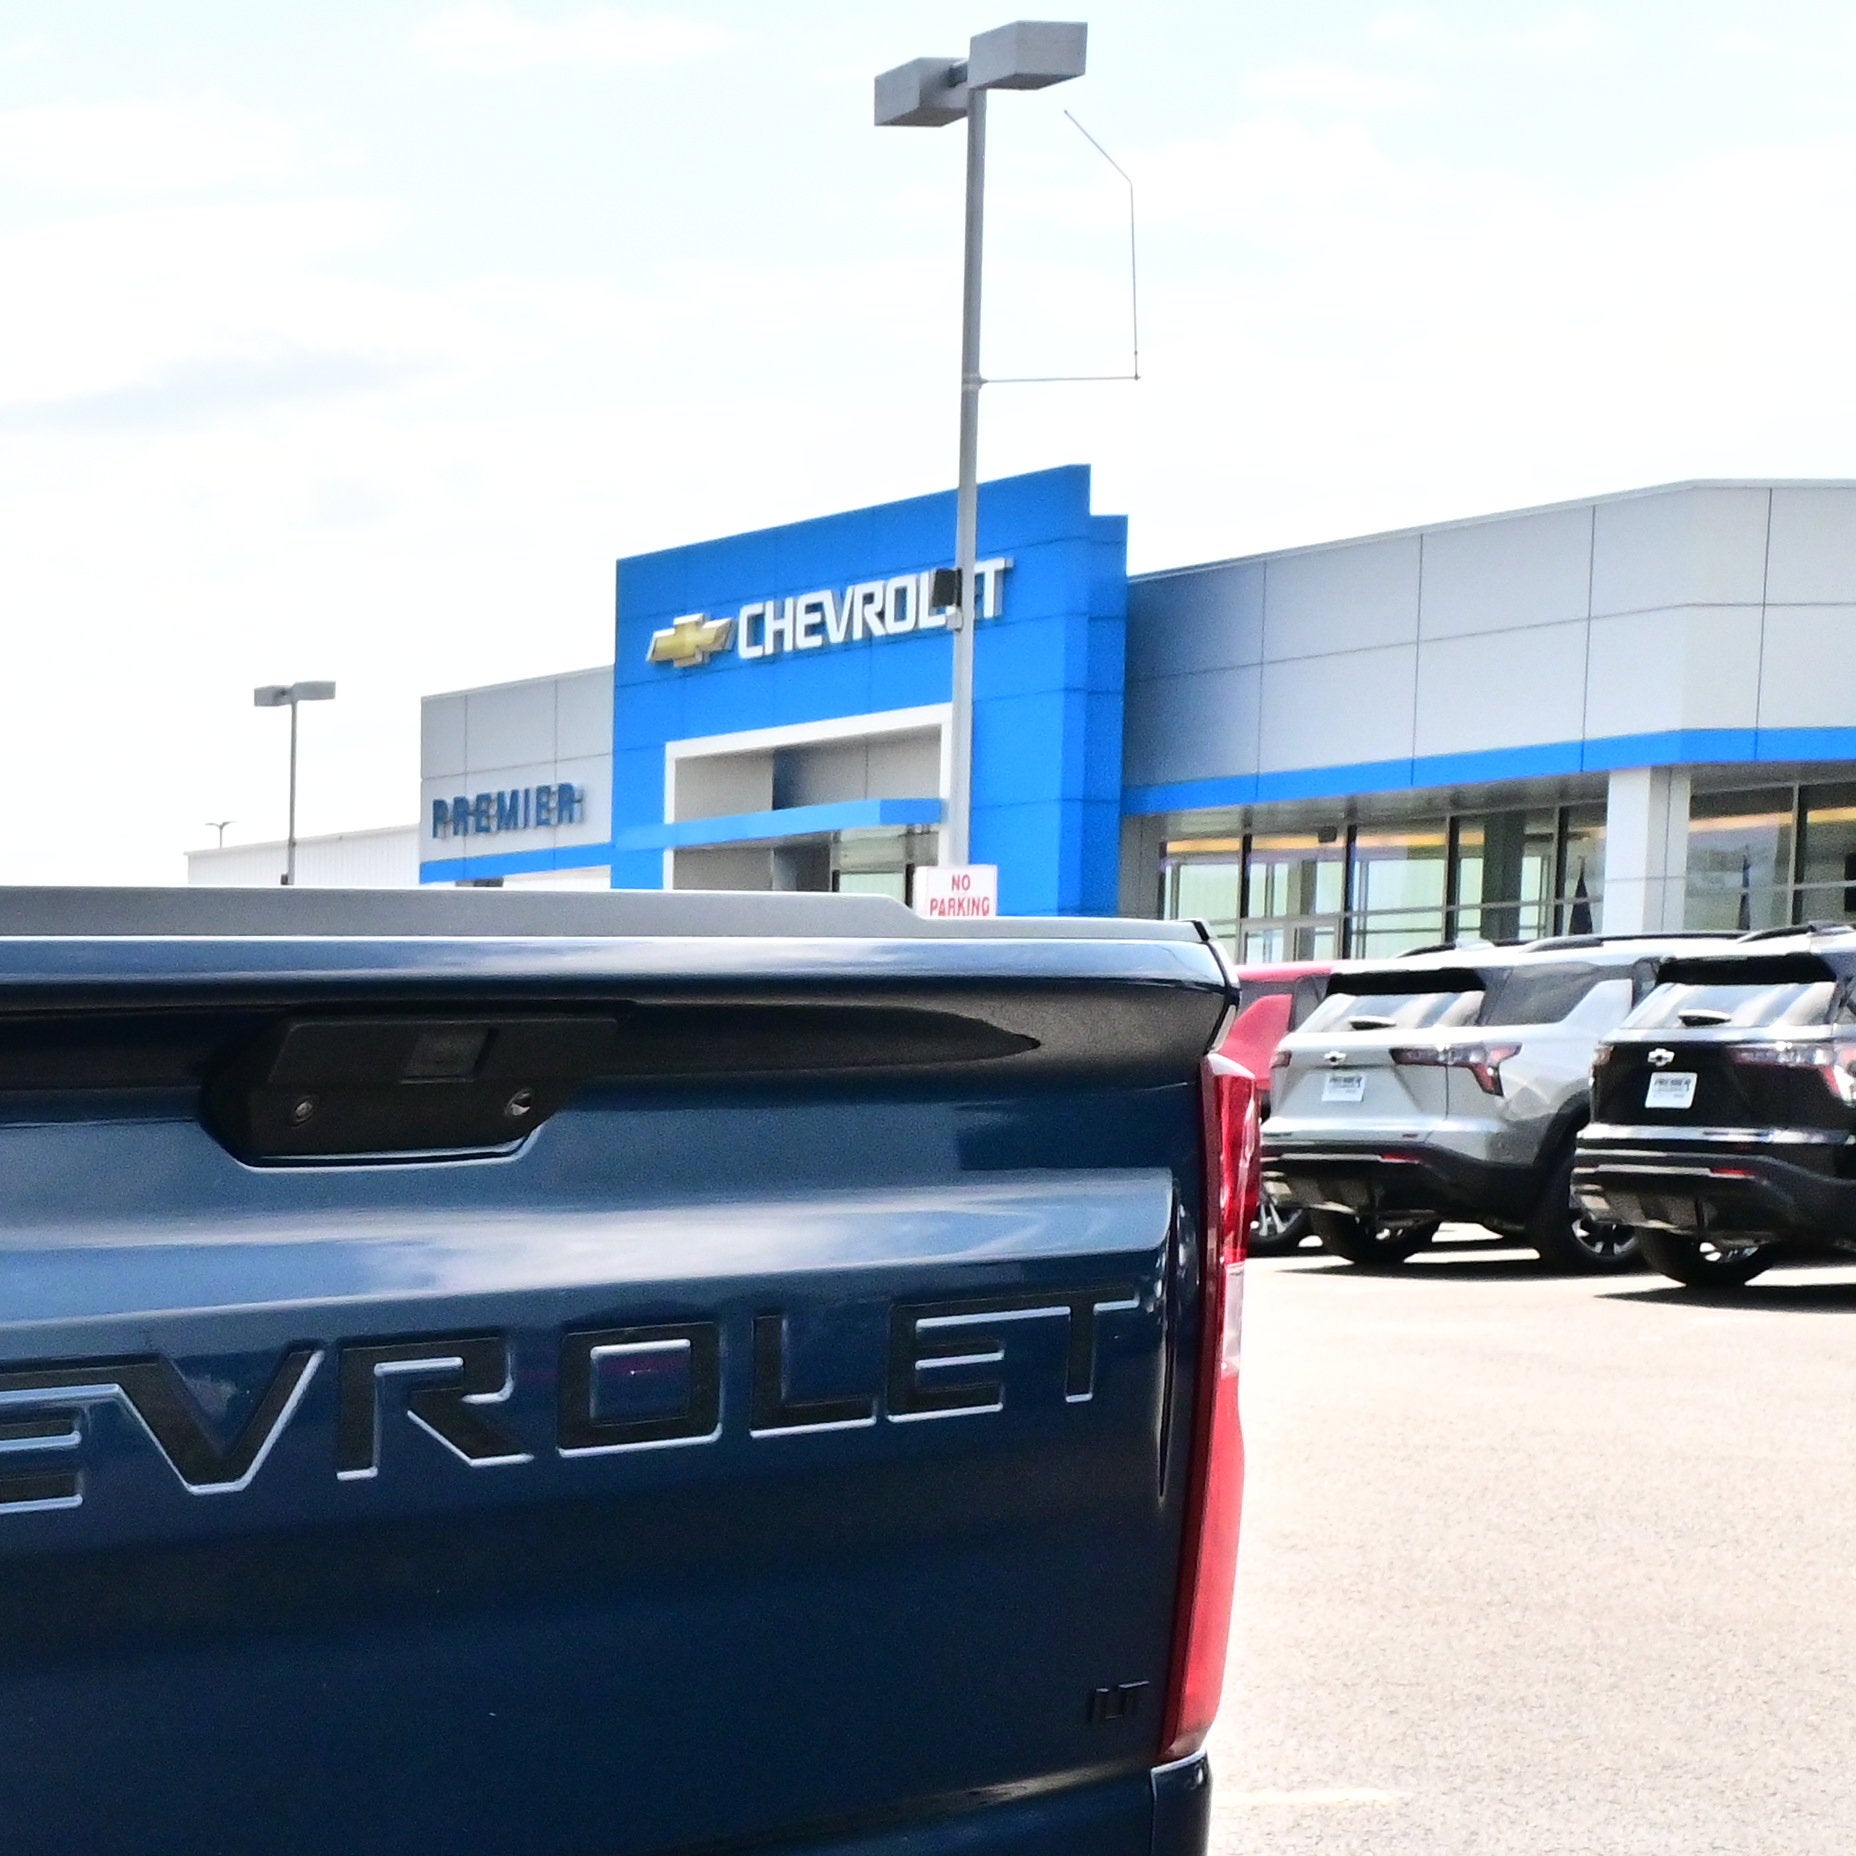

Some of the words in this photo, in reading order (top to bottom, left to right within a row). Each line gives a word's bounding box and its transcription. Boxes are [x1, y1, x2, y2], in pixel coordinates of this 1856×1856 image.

[738, 557, 1011, 659] CHEVROLT
[433, 782, 579, 838] PREMIER
[951, 874, 971, 891] NO
[929, 896, 990, 916] PARKING
